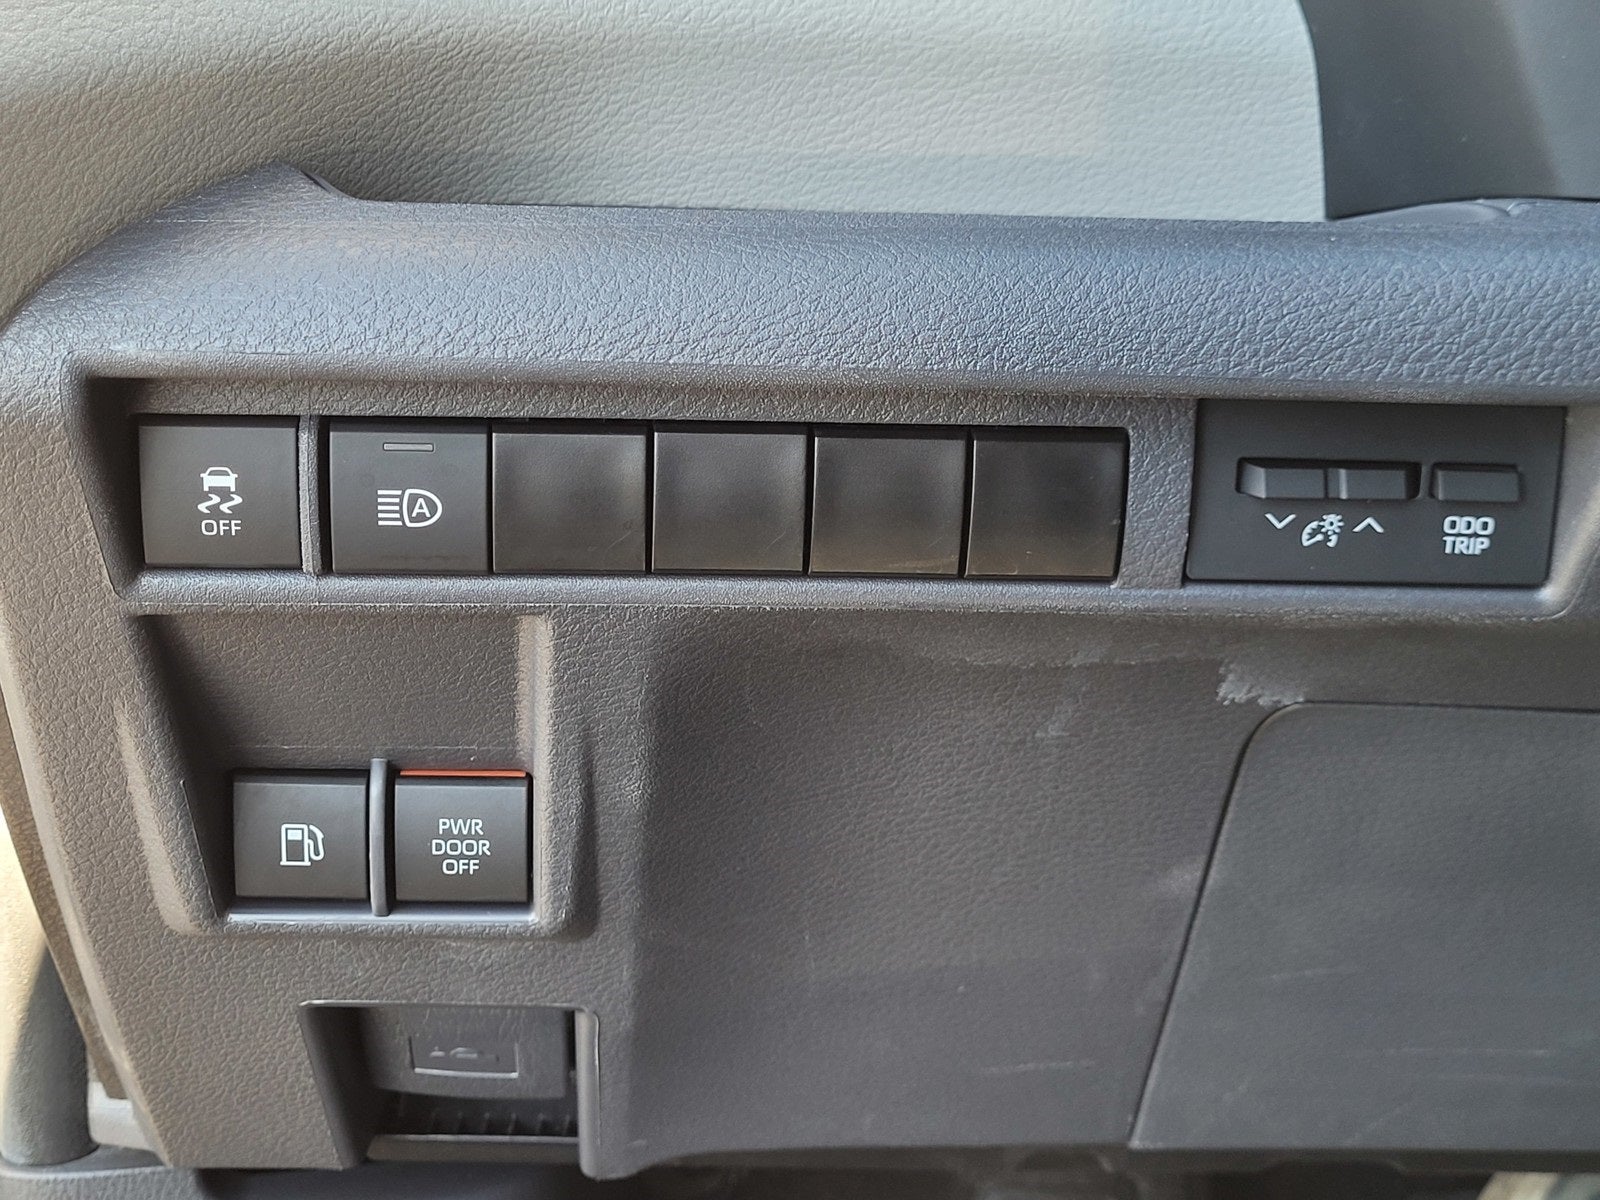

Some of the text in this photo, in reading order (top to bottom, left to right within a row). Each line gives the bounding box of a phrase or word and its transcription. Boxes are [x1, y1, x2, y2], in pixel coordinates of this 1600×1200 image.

[411, 497, 431, 518] A
[201, 519, 242, 536] OFF
[1443, 516, 1495, 535] ODO
[1442, 536, 1490, 555] TRIP
[438, 818, 484, 835] PWR
[431, 839, 491, 856] DOOR
[442, 859, 480, 875] OFF
